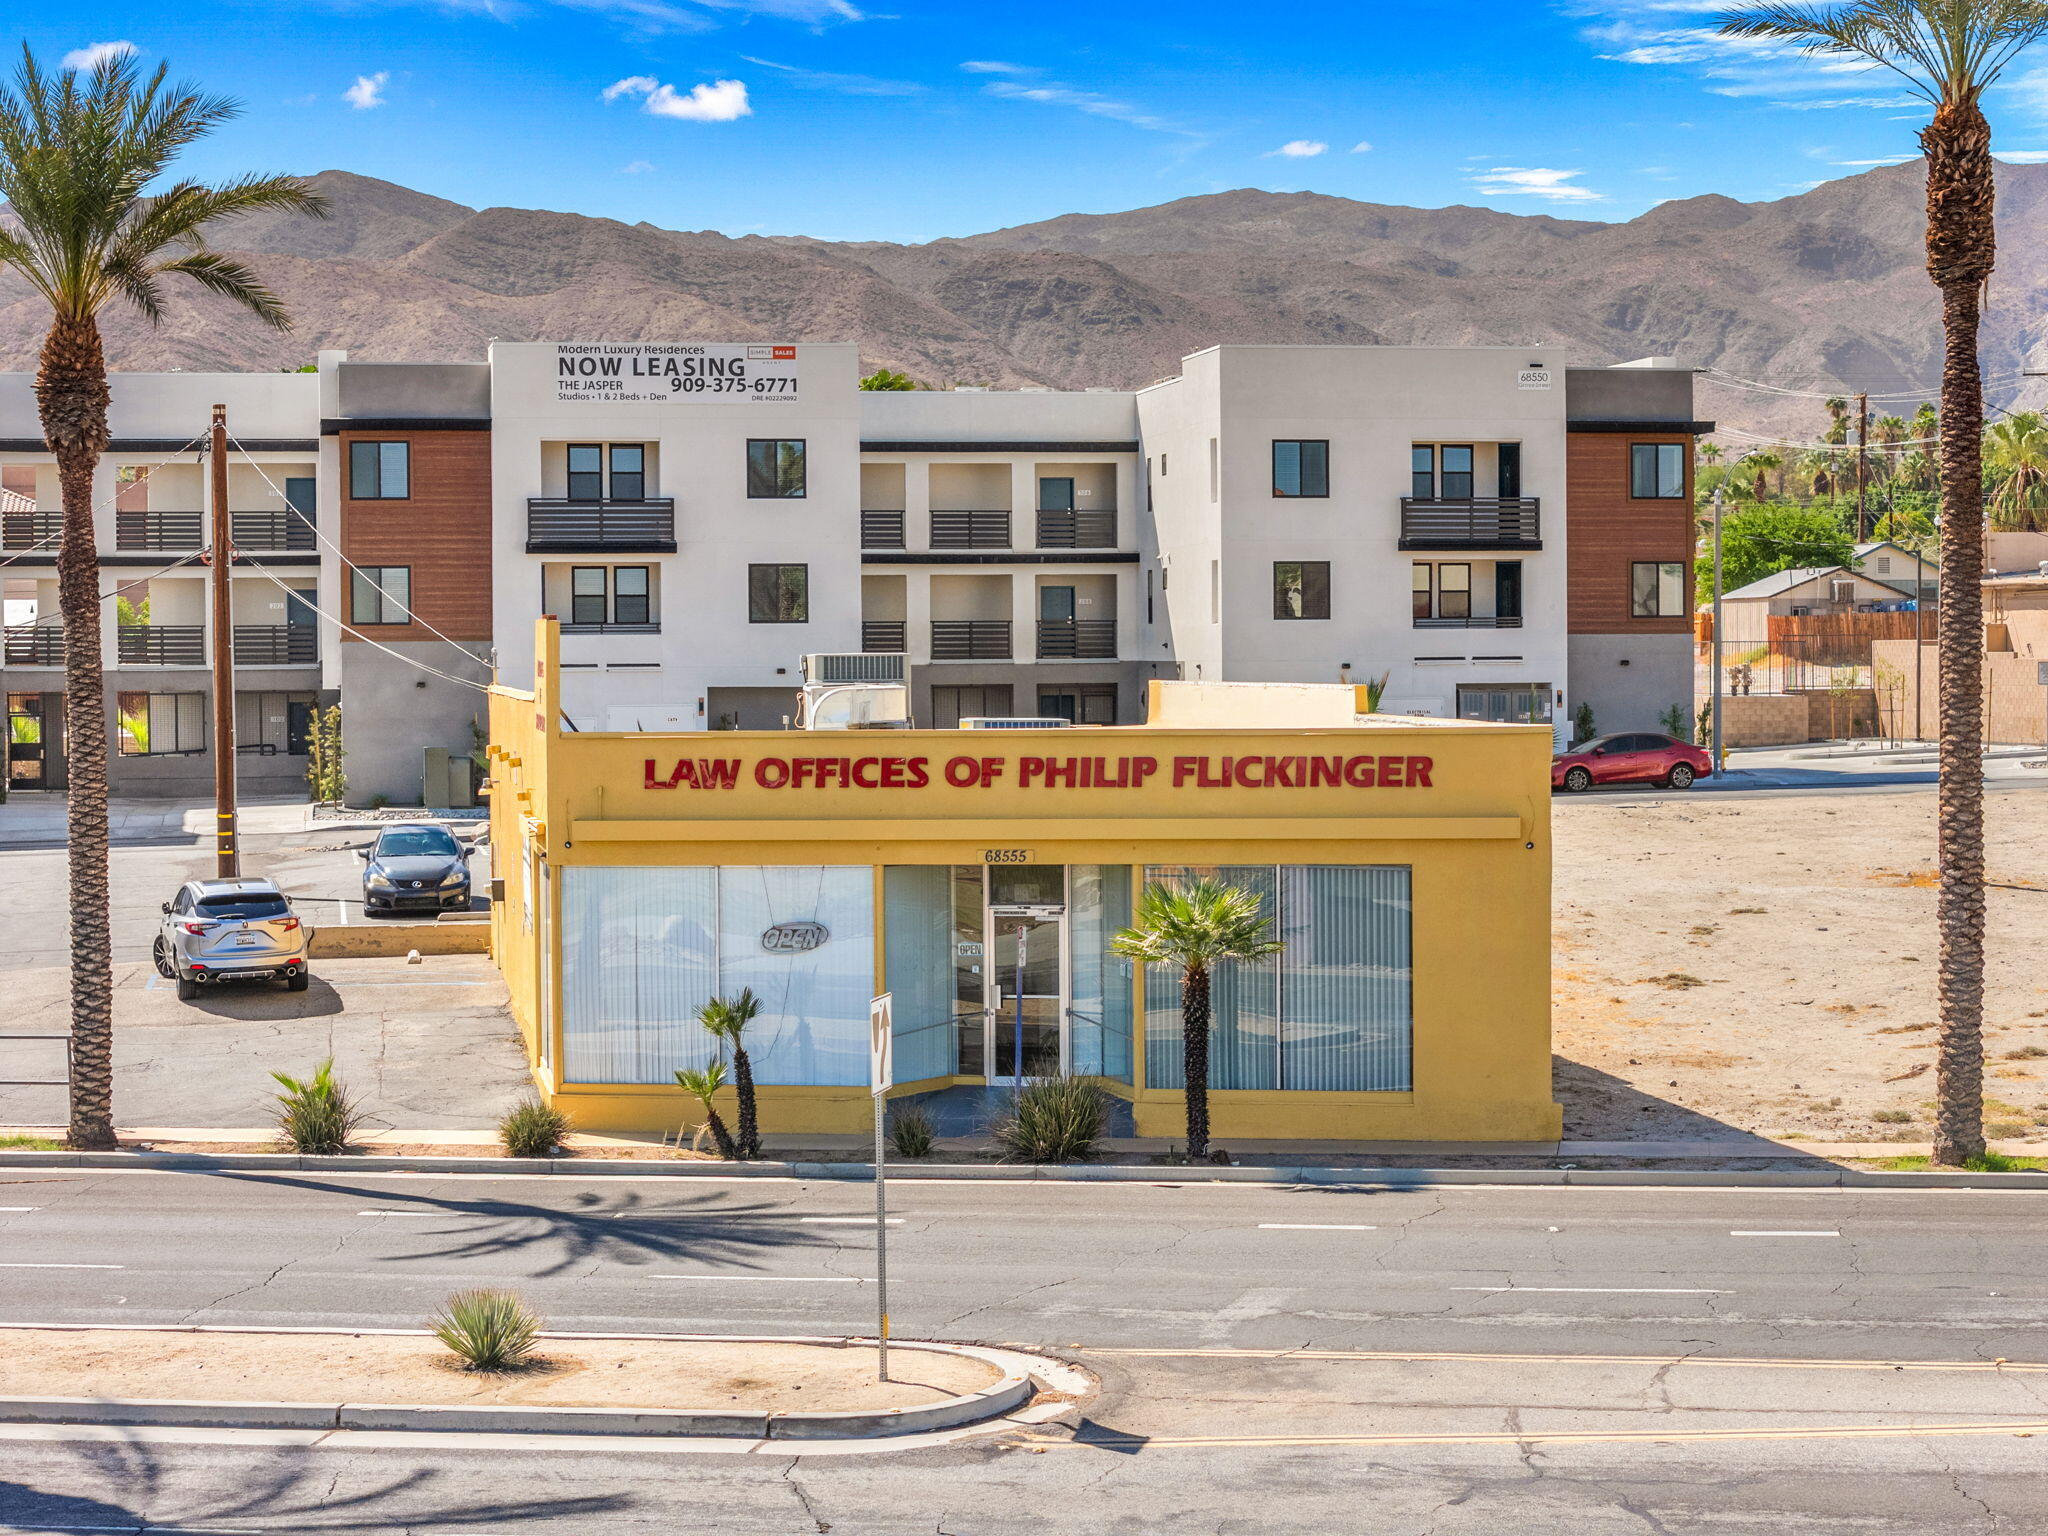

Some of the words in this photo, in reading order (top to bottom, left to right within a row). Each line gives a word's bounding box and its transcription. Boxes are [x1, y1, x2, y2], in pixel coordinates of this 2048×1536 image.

[558, 345, 601, 354] Modern
[604, 345, 641, 356] Luxury
[644, 345, 705, 354] Residences
[559, 357, 622, 376] NOW
[633, 357, 745, 377] LEASING
[1520, 372, 1548, 382] 68550
[558, 380, 580, 390] THE
[582, 380, 623, 390] JASPER
[671, 377, 797, 392] 909-375-6771
[558, 392, 590, 400] Studios
[620, 392, 640, 400] Beds
[644, 759, 741, 789] LAW
[754, 757, 930, 788] OFFICES
[944, 757, 1005, 788] OF
[1018, 756, 1158, 788] PHILIP
[1173, 755, 1434, 788] FLICKINGER
[985, 849, 1027, 862] 68555
[763, 927, 823, 950] OPEN
[960, 944, 982, 955] OPEN
